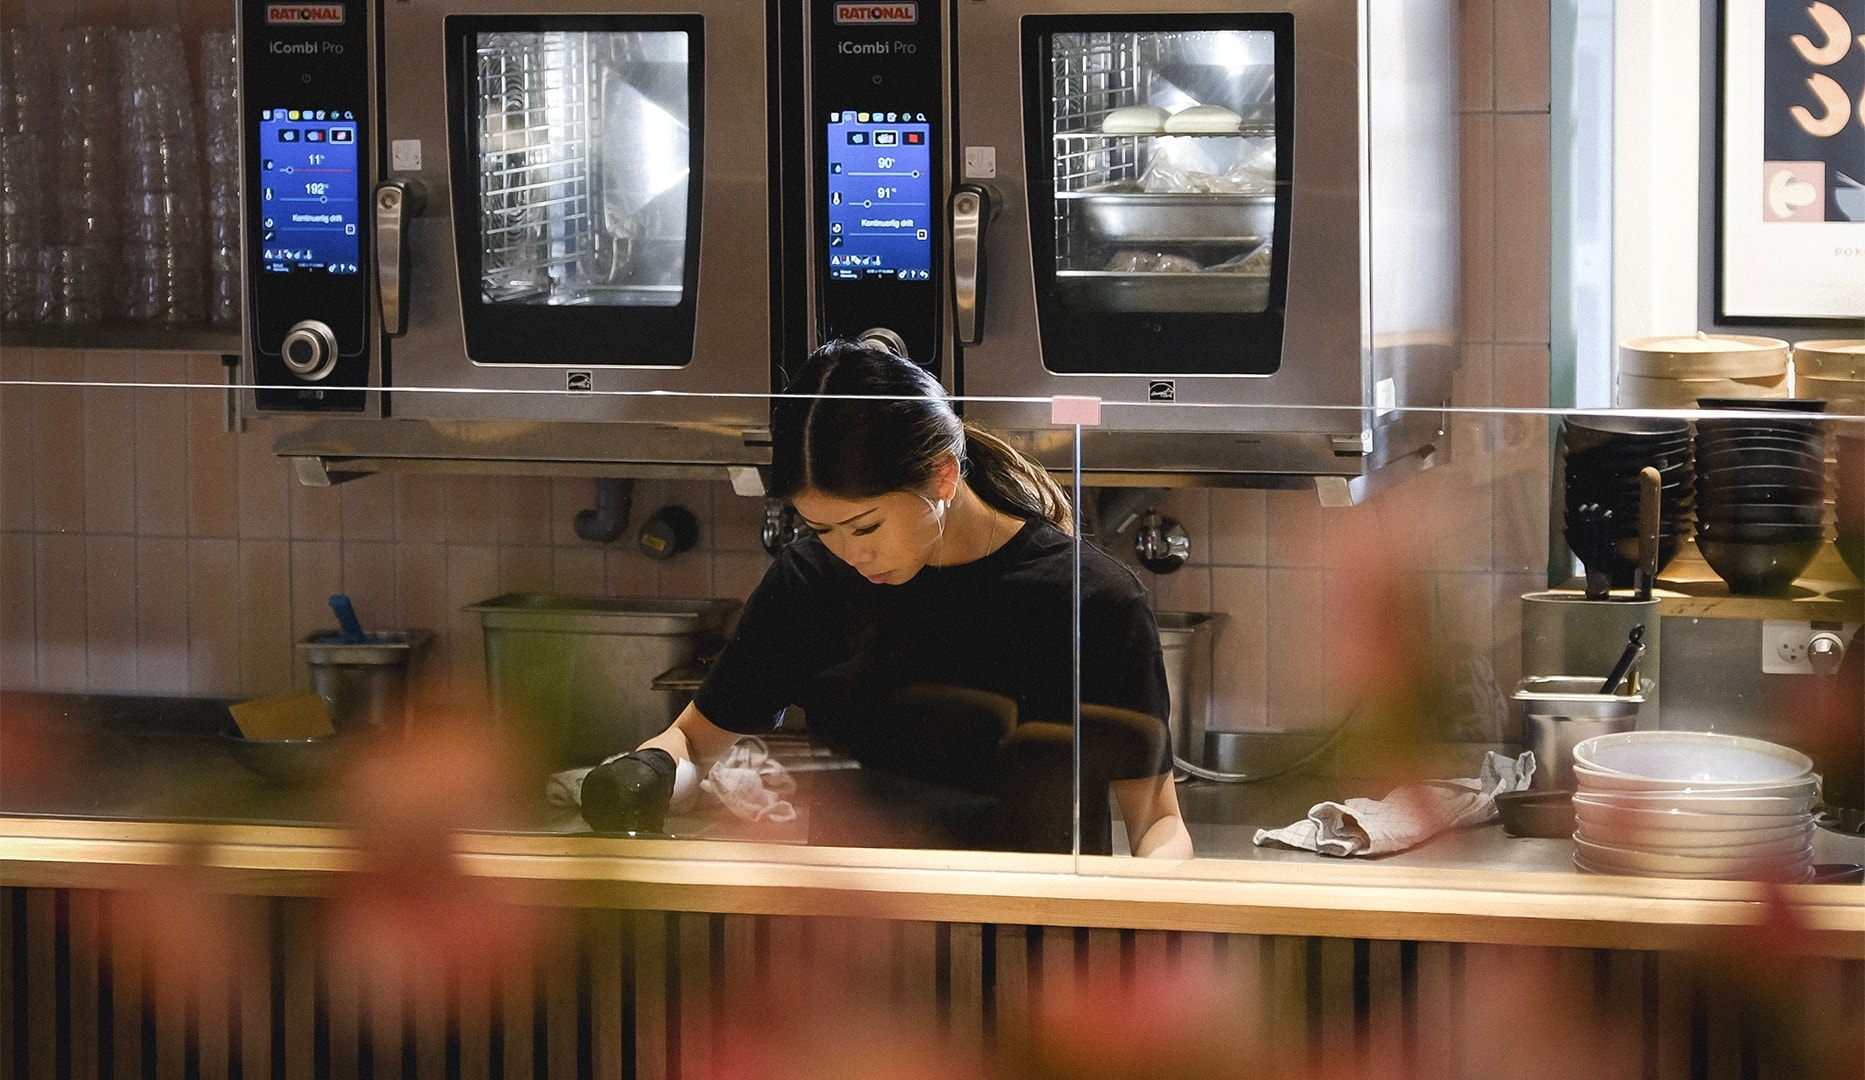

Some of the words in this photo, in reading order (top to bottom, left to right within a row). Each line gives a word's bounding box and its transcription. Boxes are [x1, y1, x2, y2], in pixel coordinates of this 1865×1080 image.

[270, 8, 340, 20] RATIONAL
[840, 7, 913, 19] RATIONAL
[269, 41, 318, 54] iCombi
[322, 41, 344, 54] Pro
[838, 41, 889, 54] iCombi
[894, 41, 917, 54] Pro
